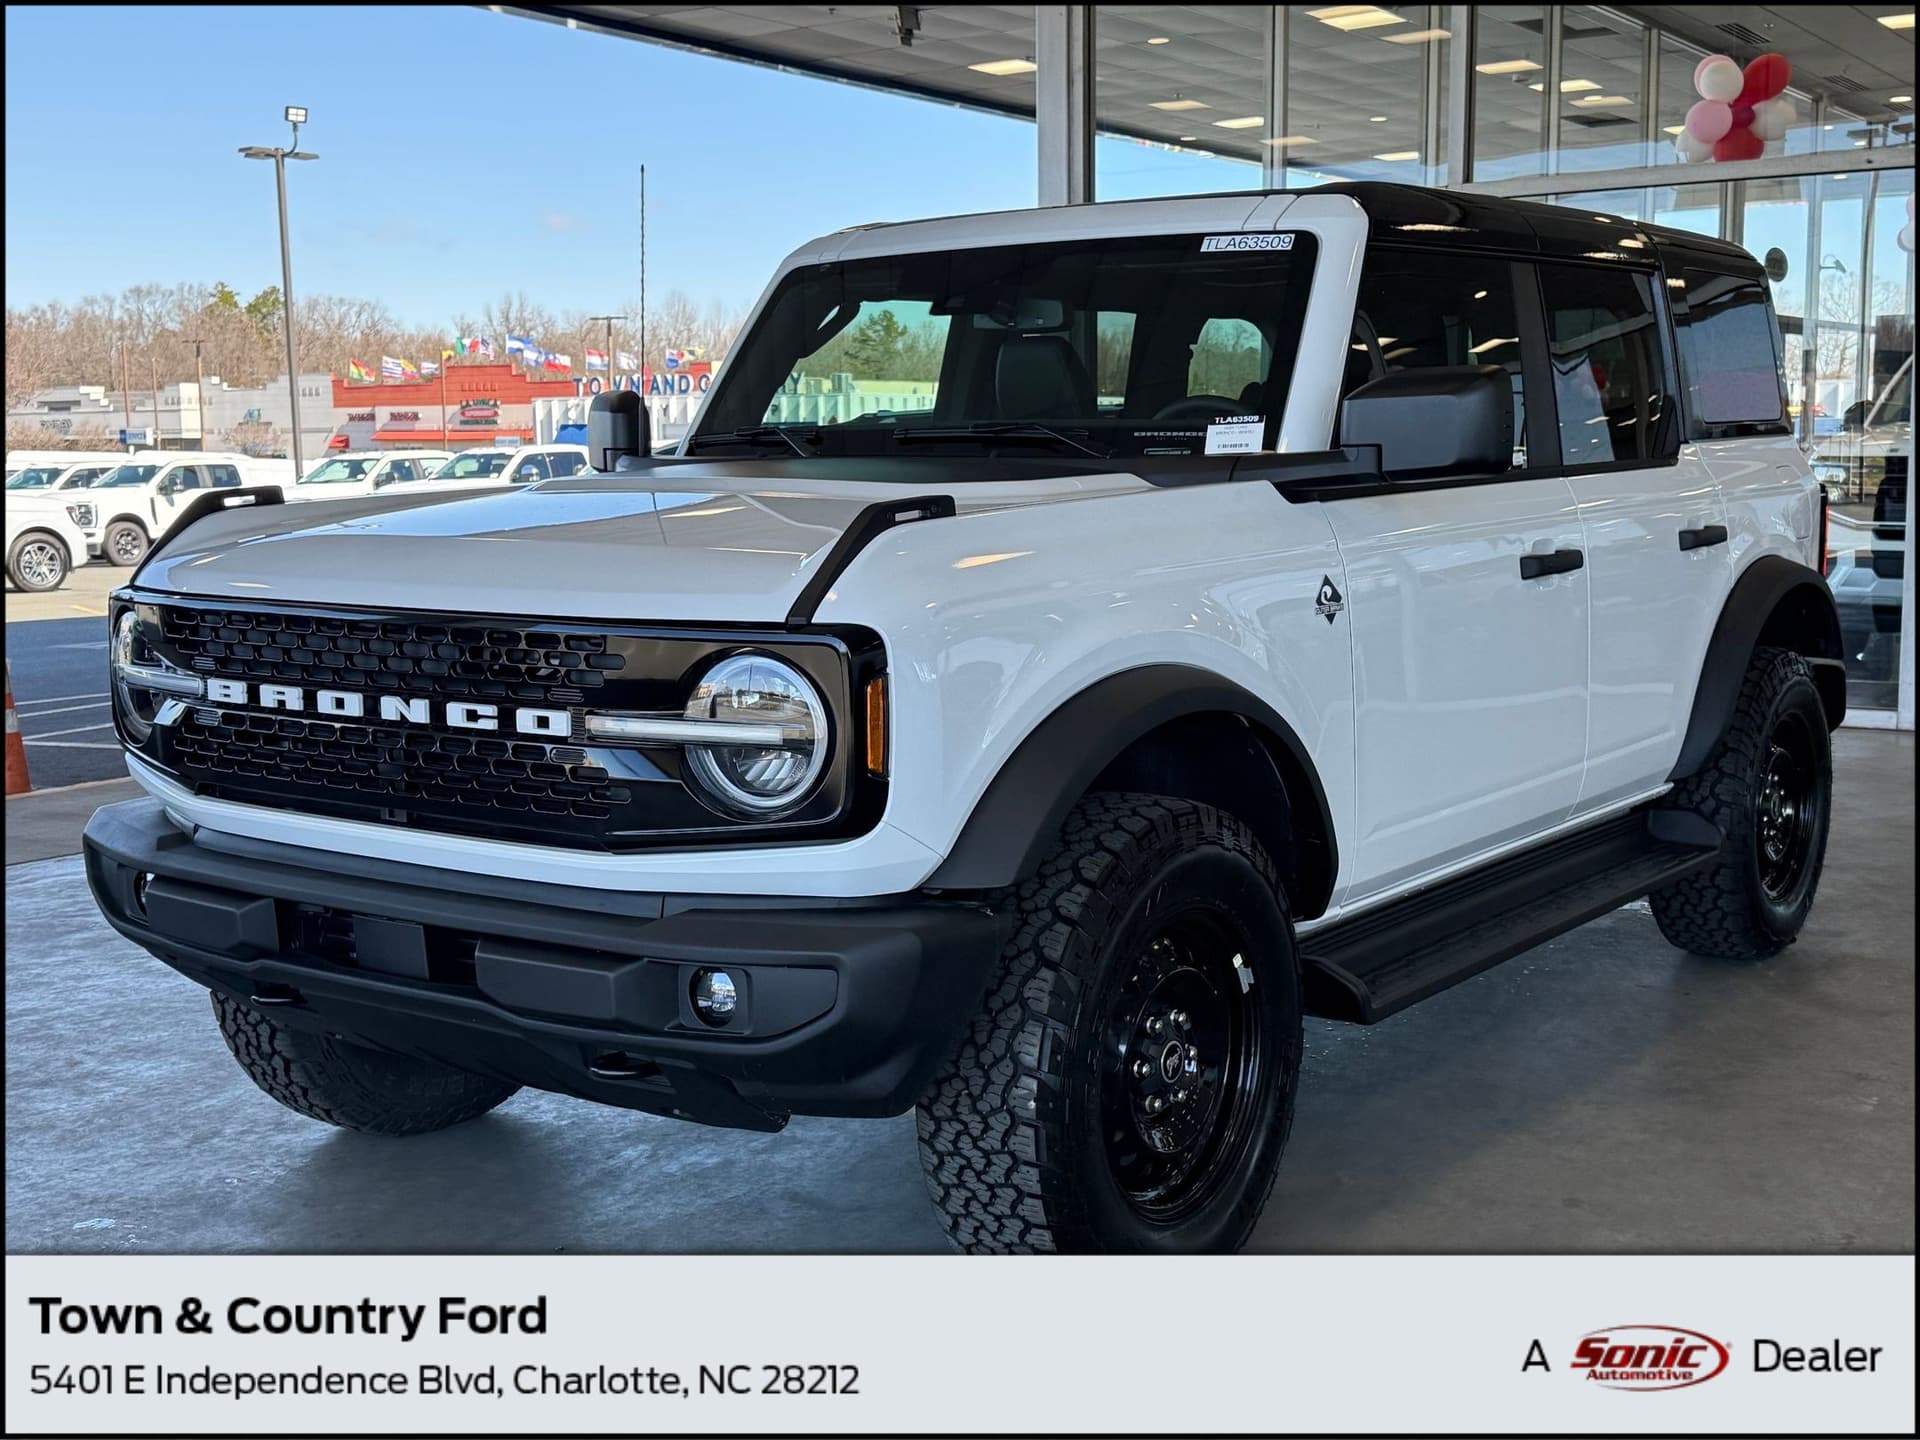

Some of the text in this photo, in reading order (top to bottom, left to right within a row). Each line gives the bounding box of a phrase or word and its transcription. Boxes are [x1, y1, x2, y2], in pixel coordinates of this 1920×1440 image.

[1205, 235, 1293, 250] TLA63509
[650, 374, 690, 396] AND
[1215, 415, 1259, 424] TLA63509
[206, 677, 573, 738] BRONCO
